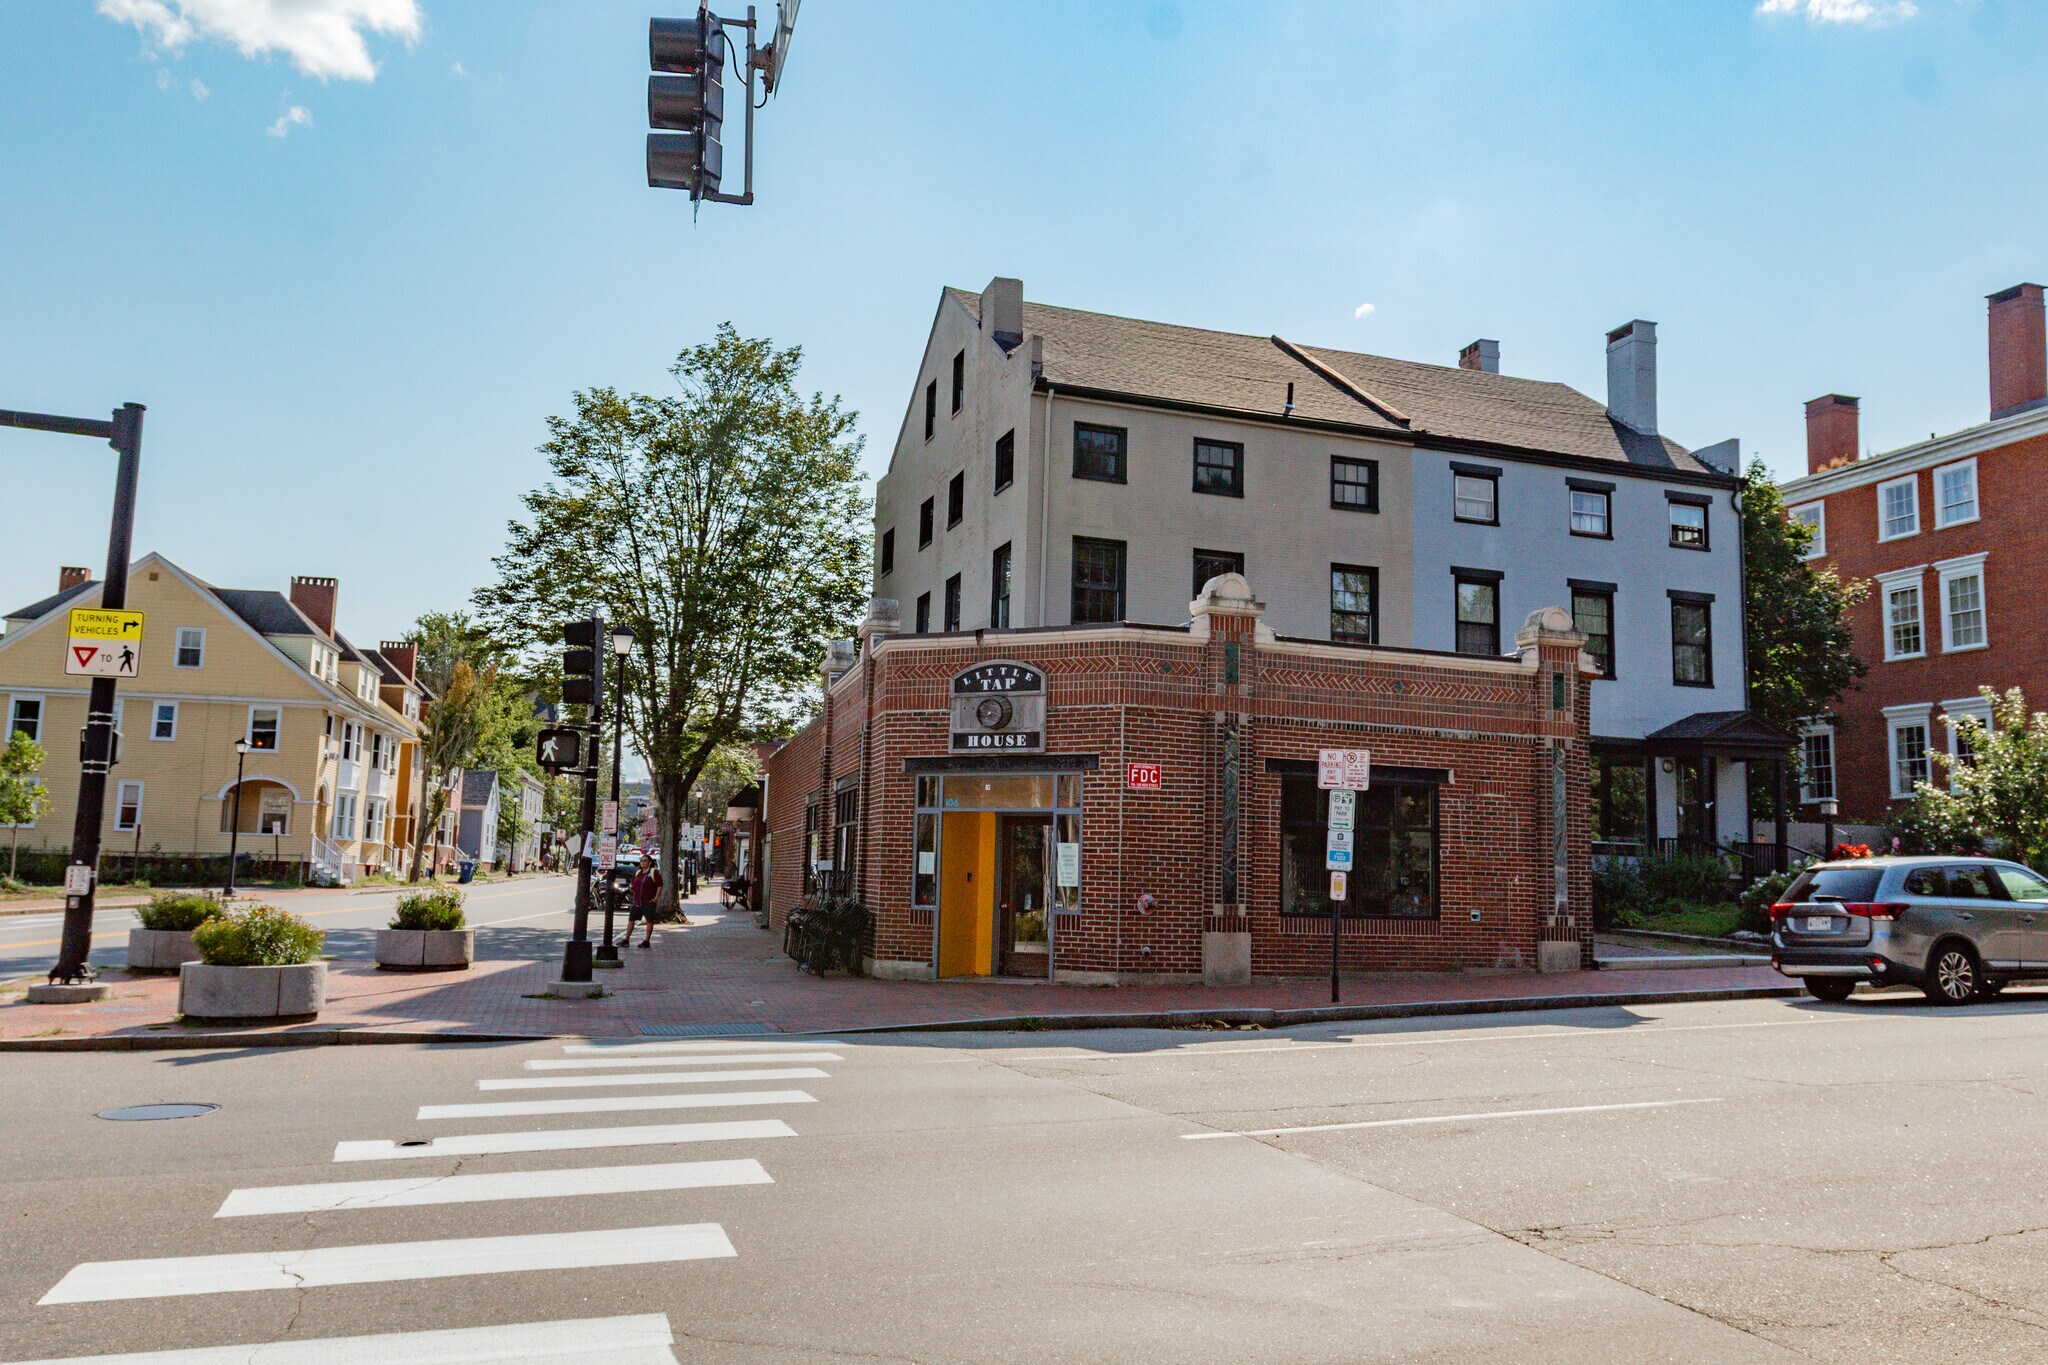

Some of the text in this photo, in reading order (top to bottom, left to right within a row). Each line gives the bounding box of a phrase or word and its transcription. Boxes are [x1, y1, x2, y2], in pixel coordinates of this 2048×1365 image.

[77, 614, 119, 624] TURNING
[74, 626, 119, 635] VEHICLES
[101, 654, 113, 663] TO
[963, 667, 1034, 686] LITTLE
[980, 678, 1016, 691] TAP
[967, 734, 1027, 747] HOUSE
[1327, 752, 1337, 761] NO
[1321, 761, 1342, 769] PARKING
[1131, 768, 1158, 783] FDC
[600, 854, 614, 863] ONLY
